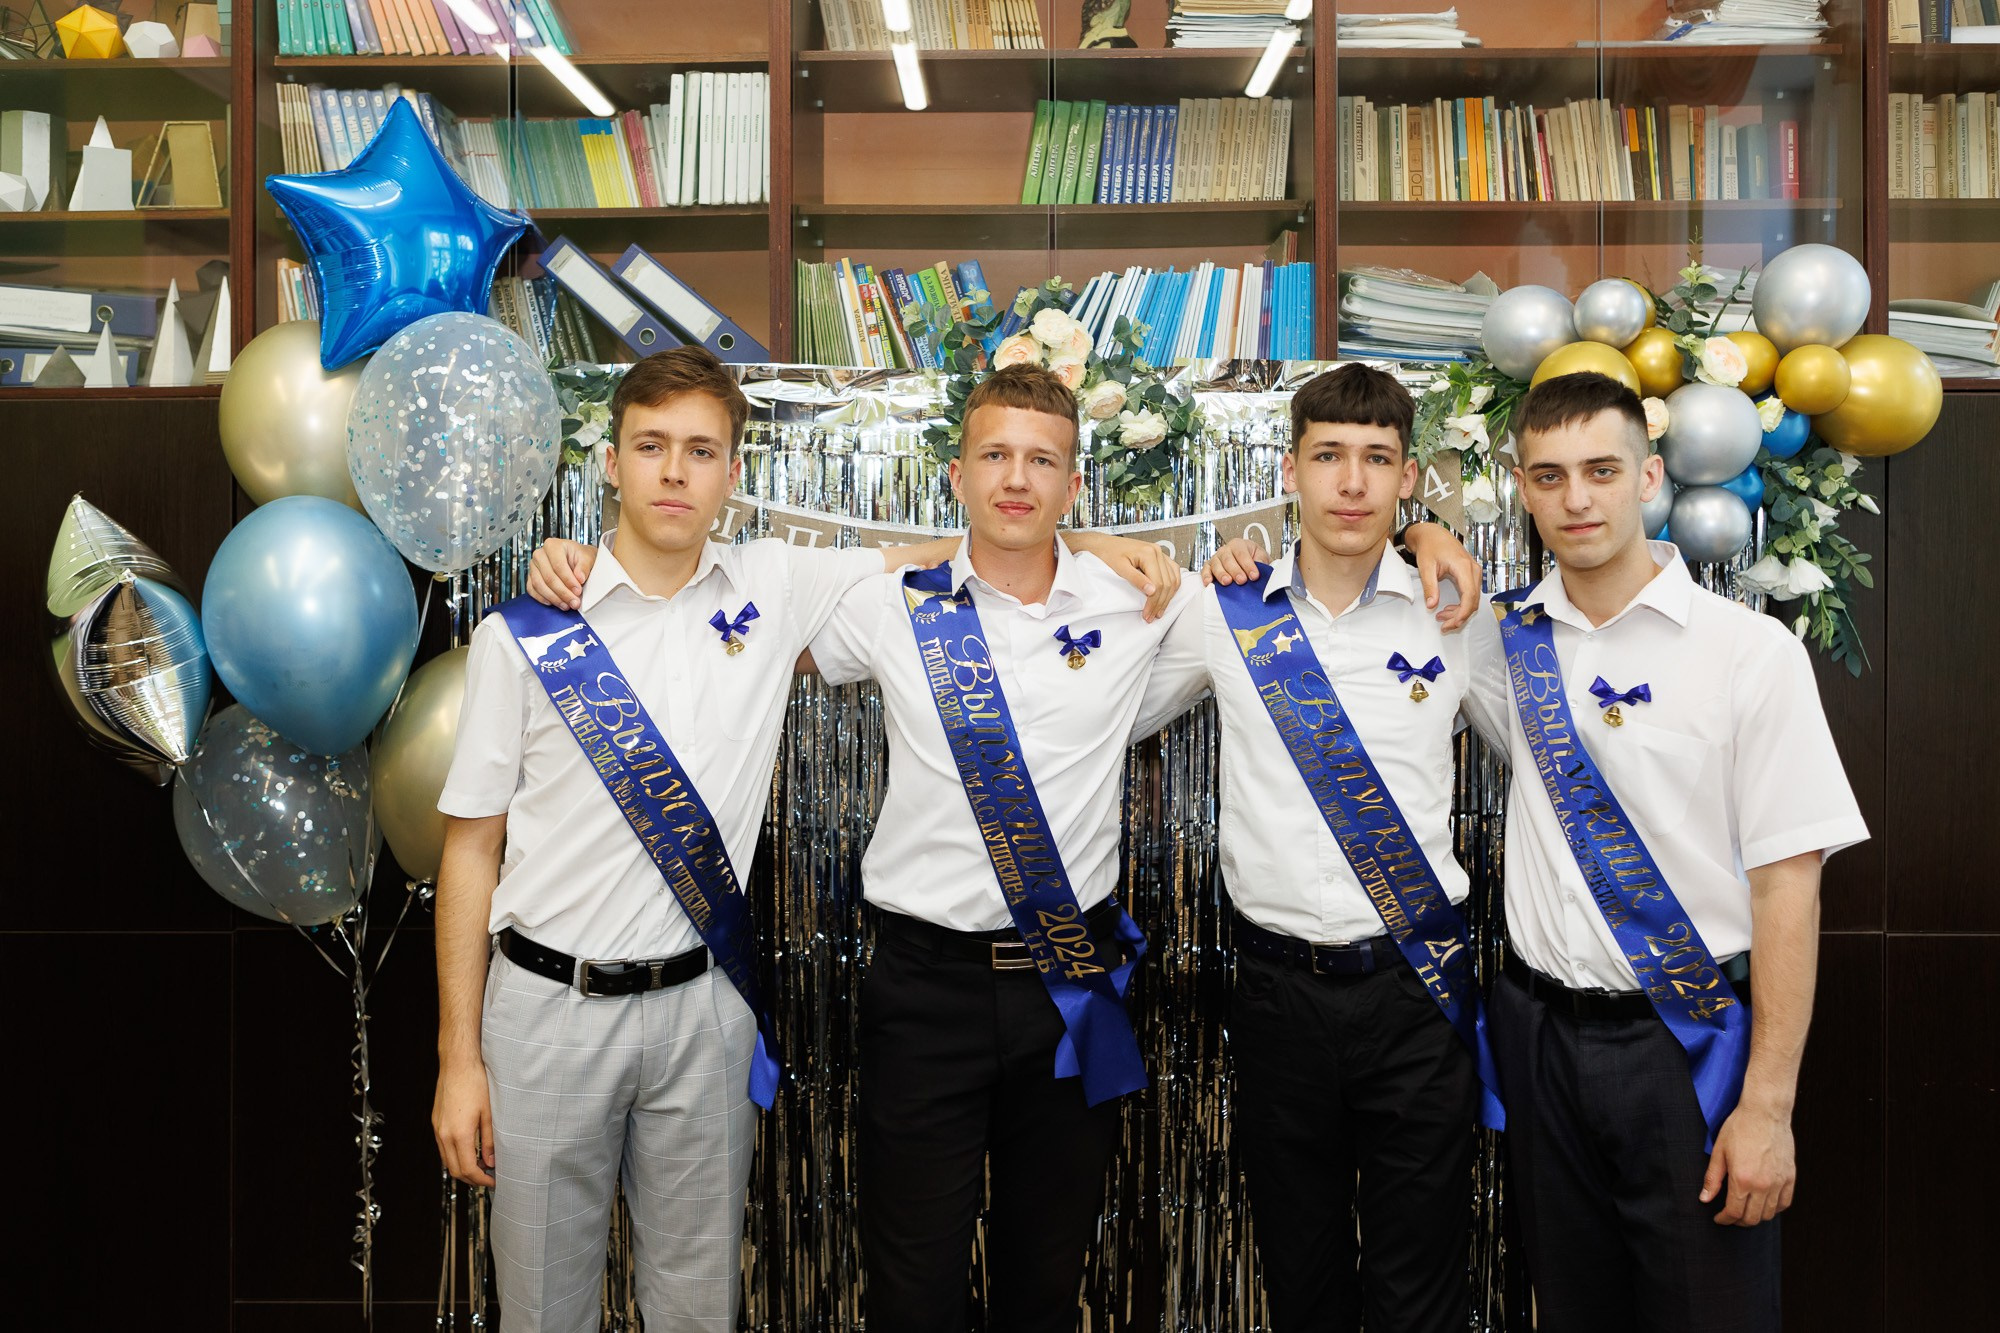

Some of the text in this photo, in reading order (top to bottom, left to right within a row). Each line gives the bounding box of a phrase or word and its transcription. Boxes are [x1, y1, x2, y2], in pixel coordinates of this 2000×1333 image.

[327, 95, 336, 106] 9
[343, 95, 352, 107] 9
[358, 96, 366, 108] 9
[374, 95, 383, 107] 9
[1030, 143, 1042, 178] АЛГЕБРА
[1085, 143, 1096, 178] АЛГЕБРА
[1895, 143, 1903, 188] ЭЛЕМЕНТАРНАЯ
[1101, 164, 1110, 204] АЛГЕБРА
[1113, 165, 1122, 204] АЛГЕБРА
[1125, 164, 1134, 203] АЛГЕБРА
[1137, 164, 1147, 203] АЛГЕБРА
[1150, 164, 1159, 203] АЛГЕБРА
[1162, 164, 1171, 203] АЛГЕБРА
[853, 308, 866, 343] АЛГЕБРА
[920, 637, 966, 730] ГИМНАЗИЯ
[1508, 651, 1543, 748] ГИМНАЗИЯ
[551, 685, 625, 780] ГИМНАЗИЯ
[1259, 680, 1323, 775] ГИМНАЗИЯ
[579, 671, 737, 903] Выпускник
[1284, 670, 1441, 922] Выпускник
[944, 634, 1106, 981] Выпускник 2024
[1522, 643, 1737, 1022] Выпускник 2024
[1022, 929, 1058, 974] 11-Б
[1627, 951, 1673, 1003] 11-Б
